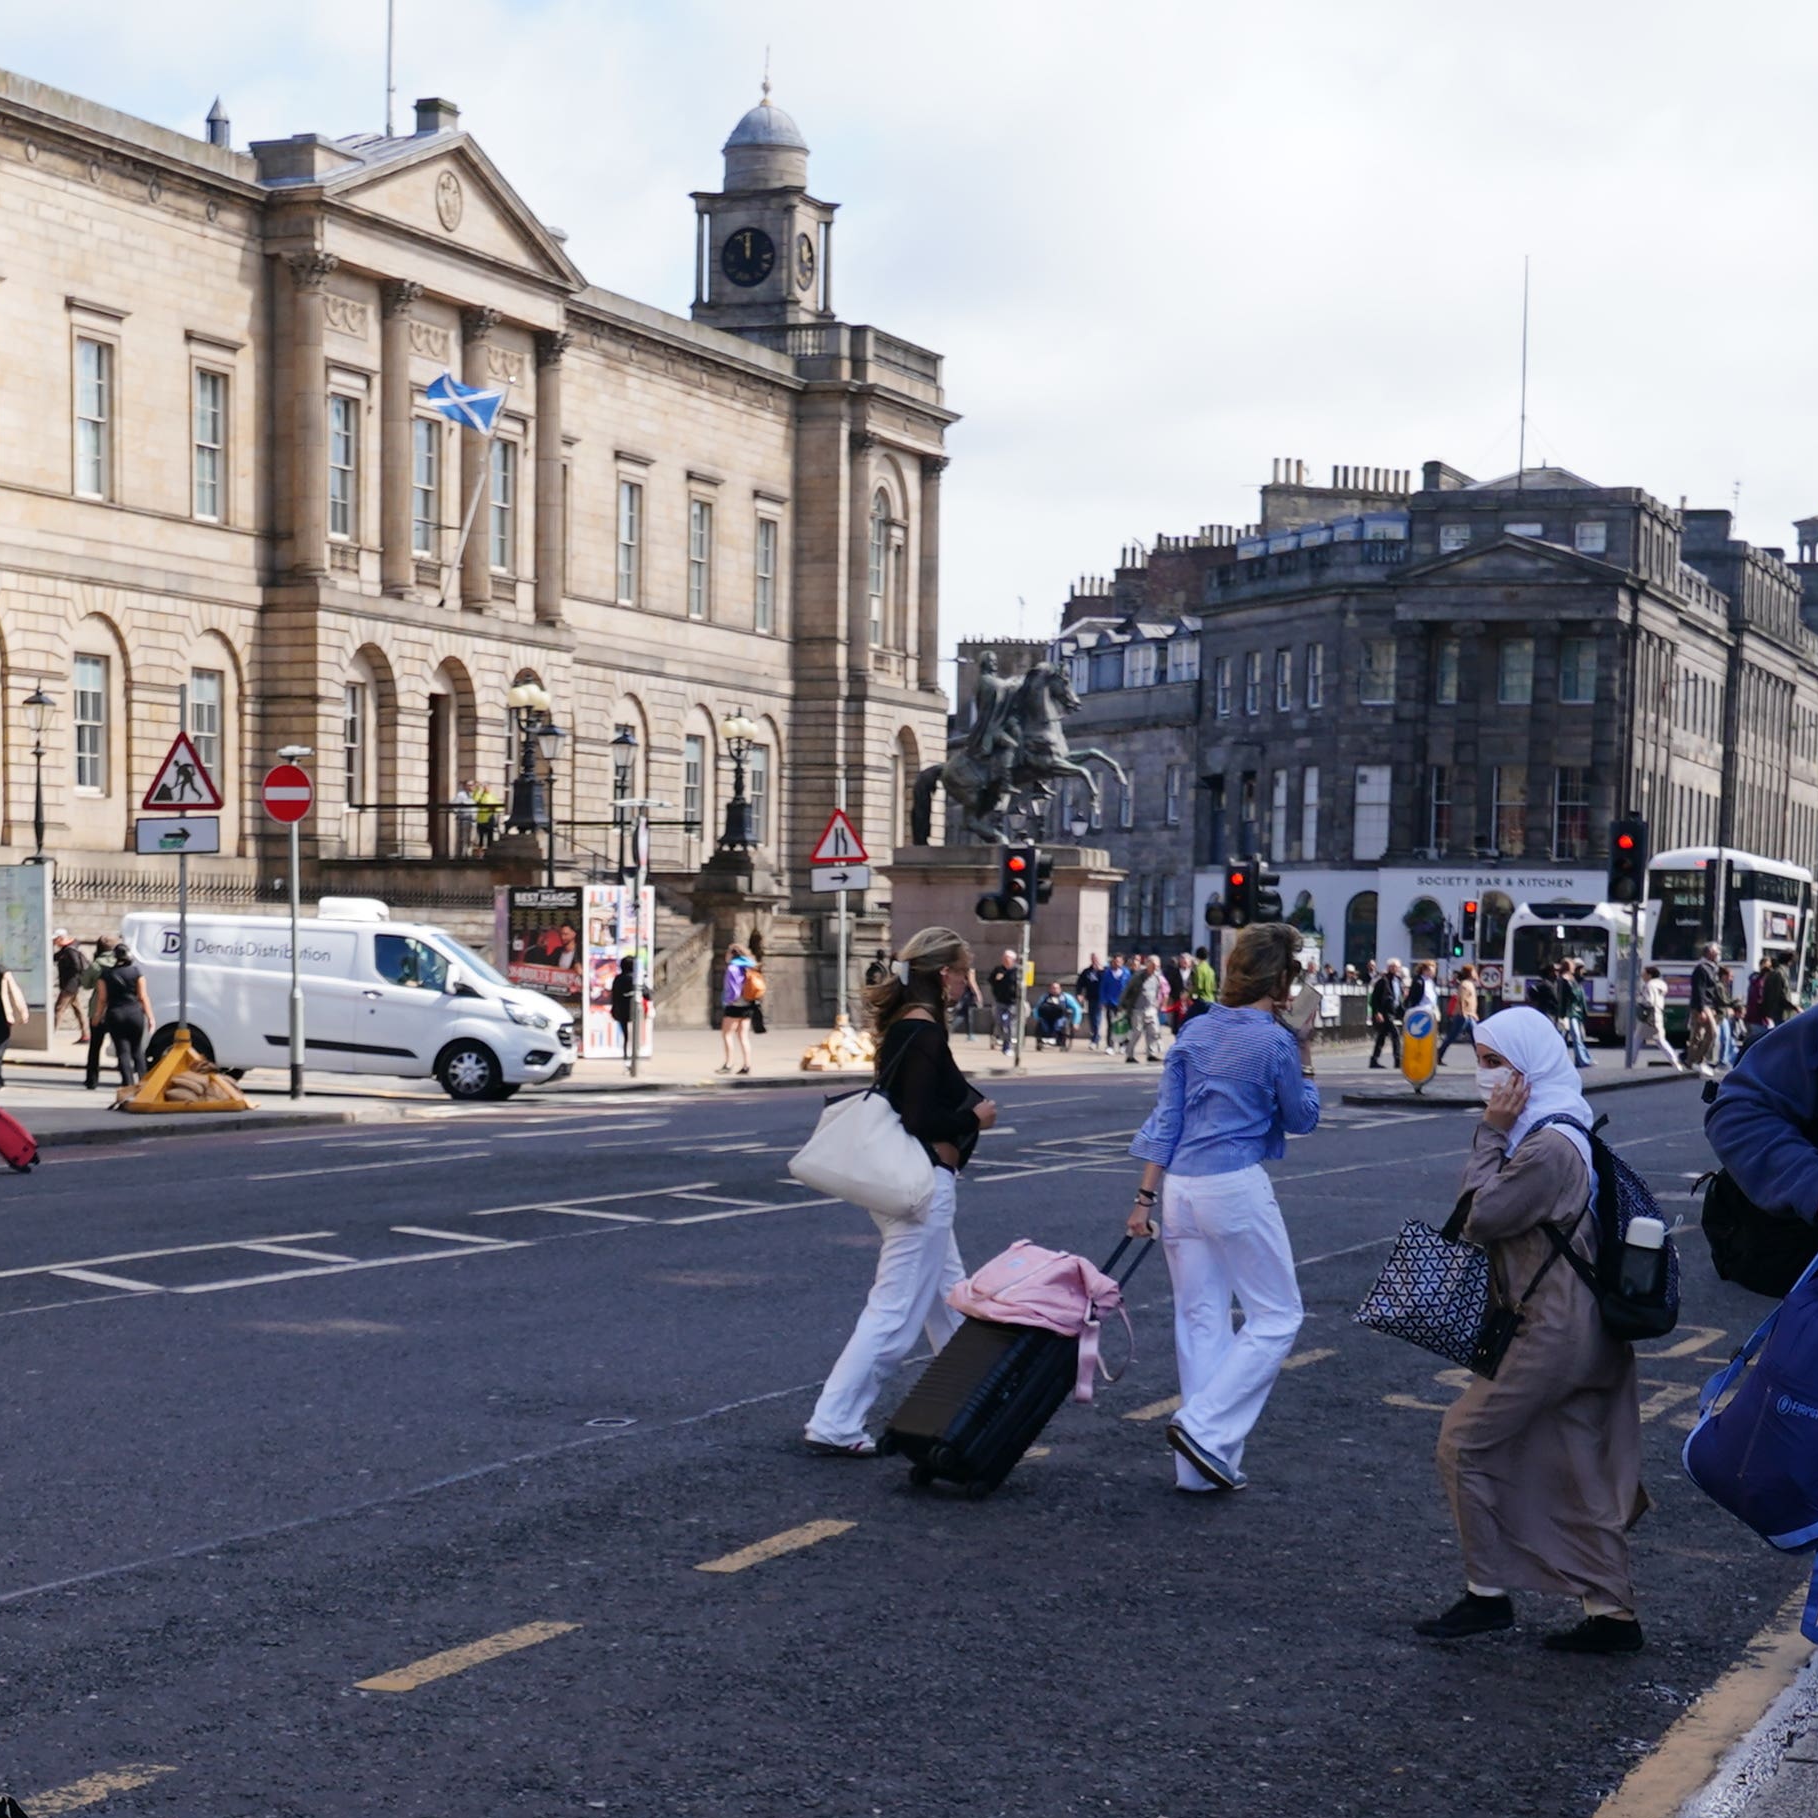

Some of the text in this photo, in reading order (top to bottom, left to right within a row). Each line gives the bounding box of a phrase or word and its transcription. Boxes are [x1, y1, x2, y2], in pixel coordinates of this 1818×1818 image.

[1417, 876, 1574, 888] SOCIETY BAR & KITCHEN
[514, 891, 577, 904] BEST MAGIC
[1483, 971, 1499, 983] 20
